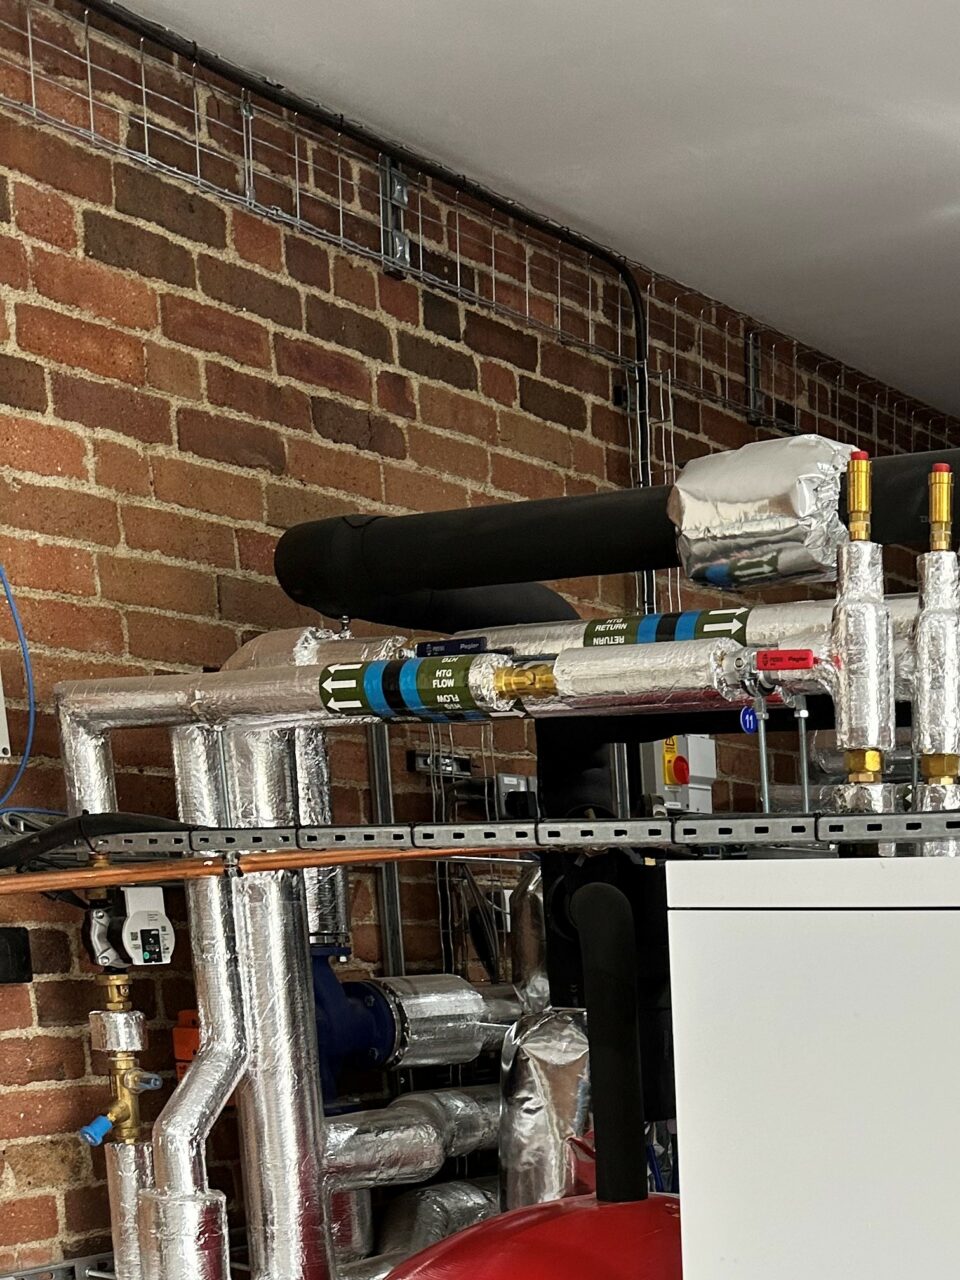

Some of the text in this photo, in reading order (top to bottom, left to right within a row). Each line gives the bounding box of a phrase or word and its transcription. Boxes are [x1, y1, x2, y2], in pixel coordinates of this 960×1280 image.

[594, 623, 628, 632] RETURN
[592, 635, 625, 646] RETURN
[435, 669, 452, 678] HTG
[432, 679, 455, 689] FLOW
[436, 694, 460, 703] FLOW
[745, 713, 754, 730] 11
